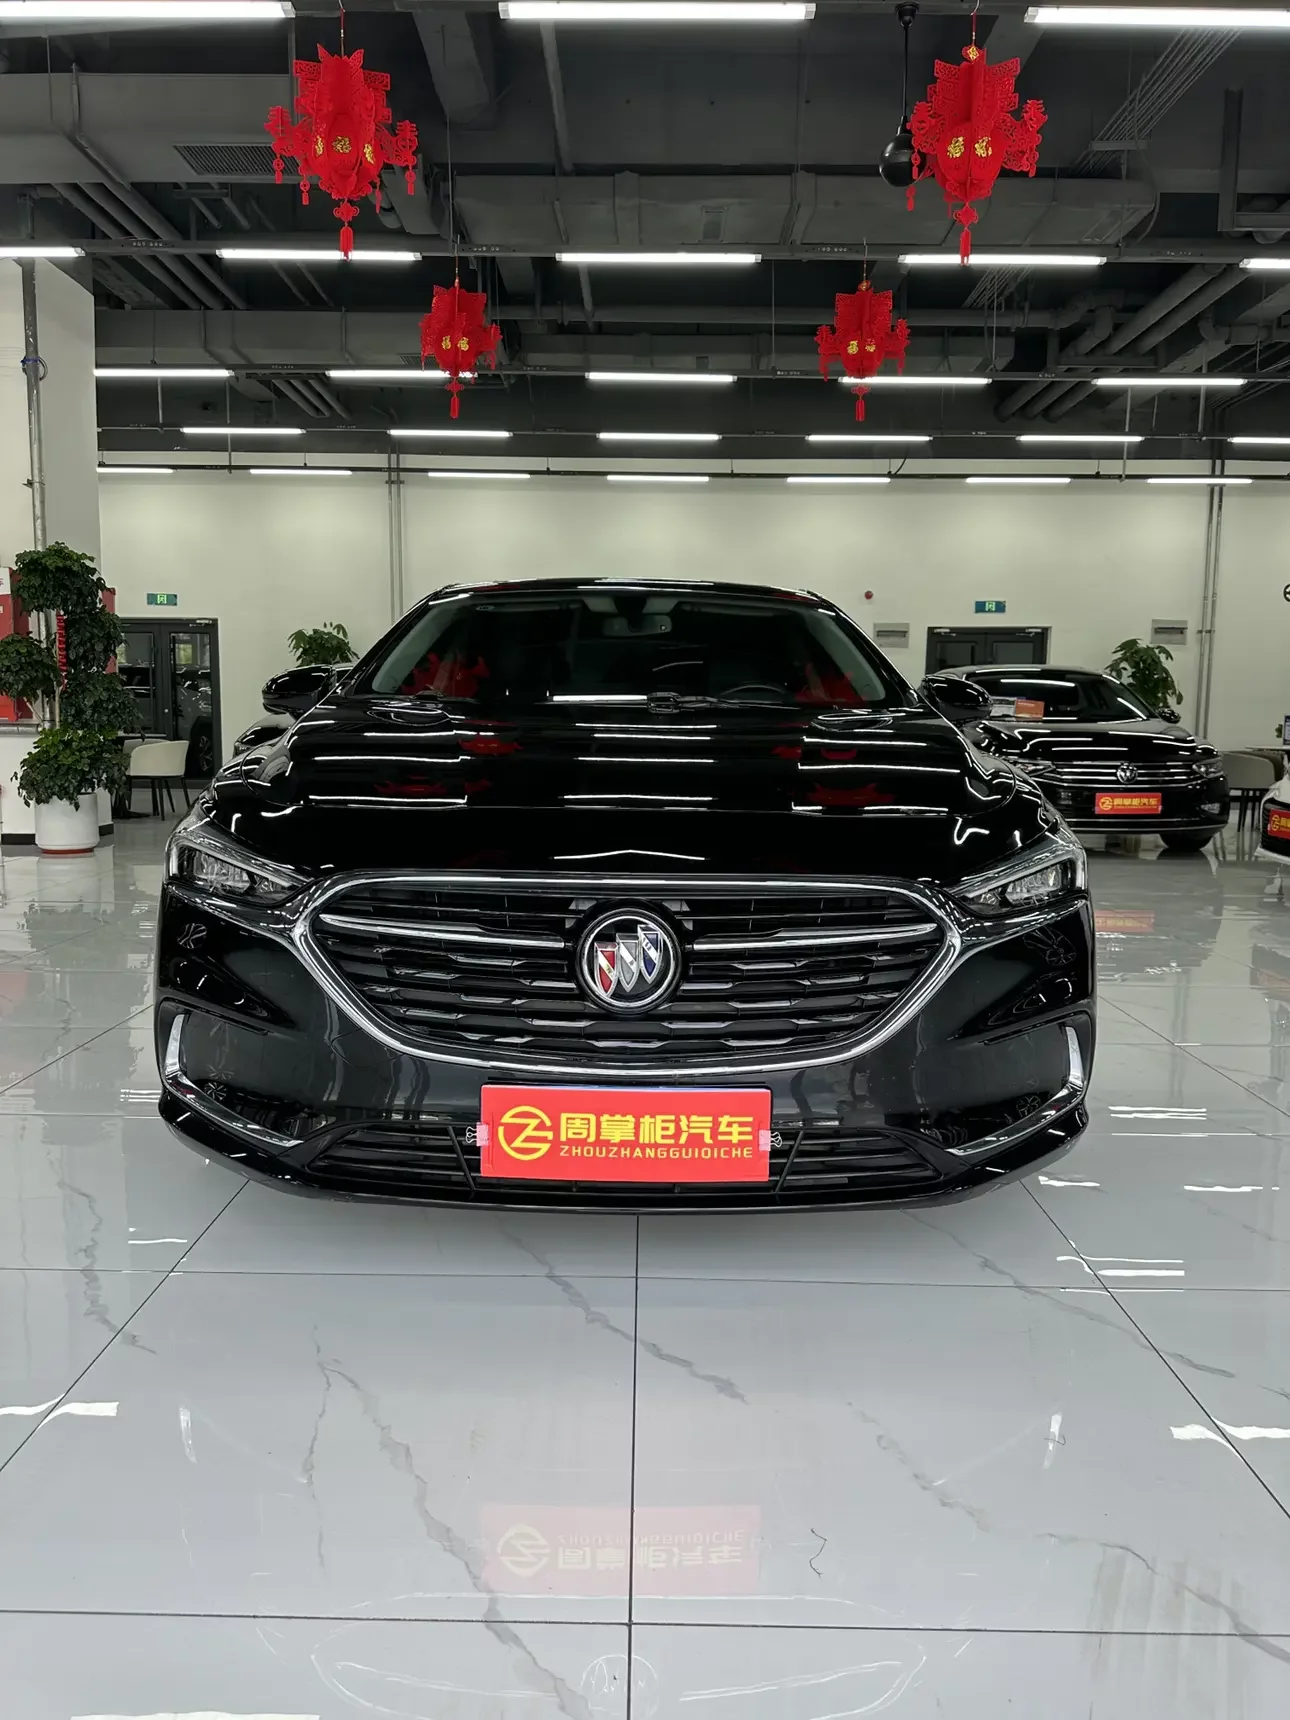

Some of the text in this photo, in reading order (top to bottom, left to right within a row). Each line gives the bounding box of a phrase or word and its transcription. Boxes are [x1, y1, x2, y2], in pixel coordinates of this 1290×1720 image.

[559, 1112, 754, 1144] 周掌柜汽车
